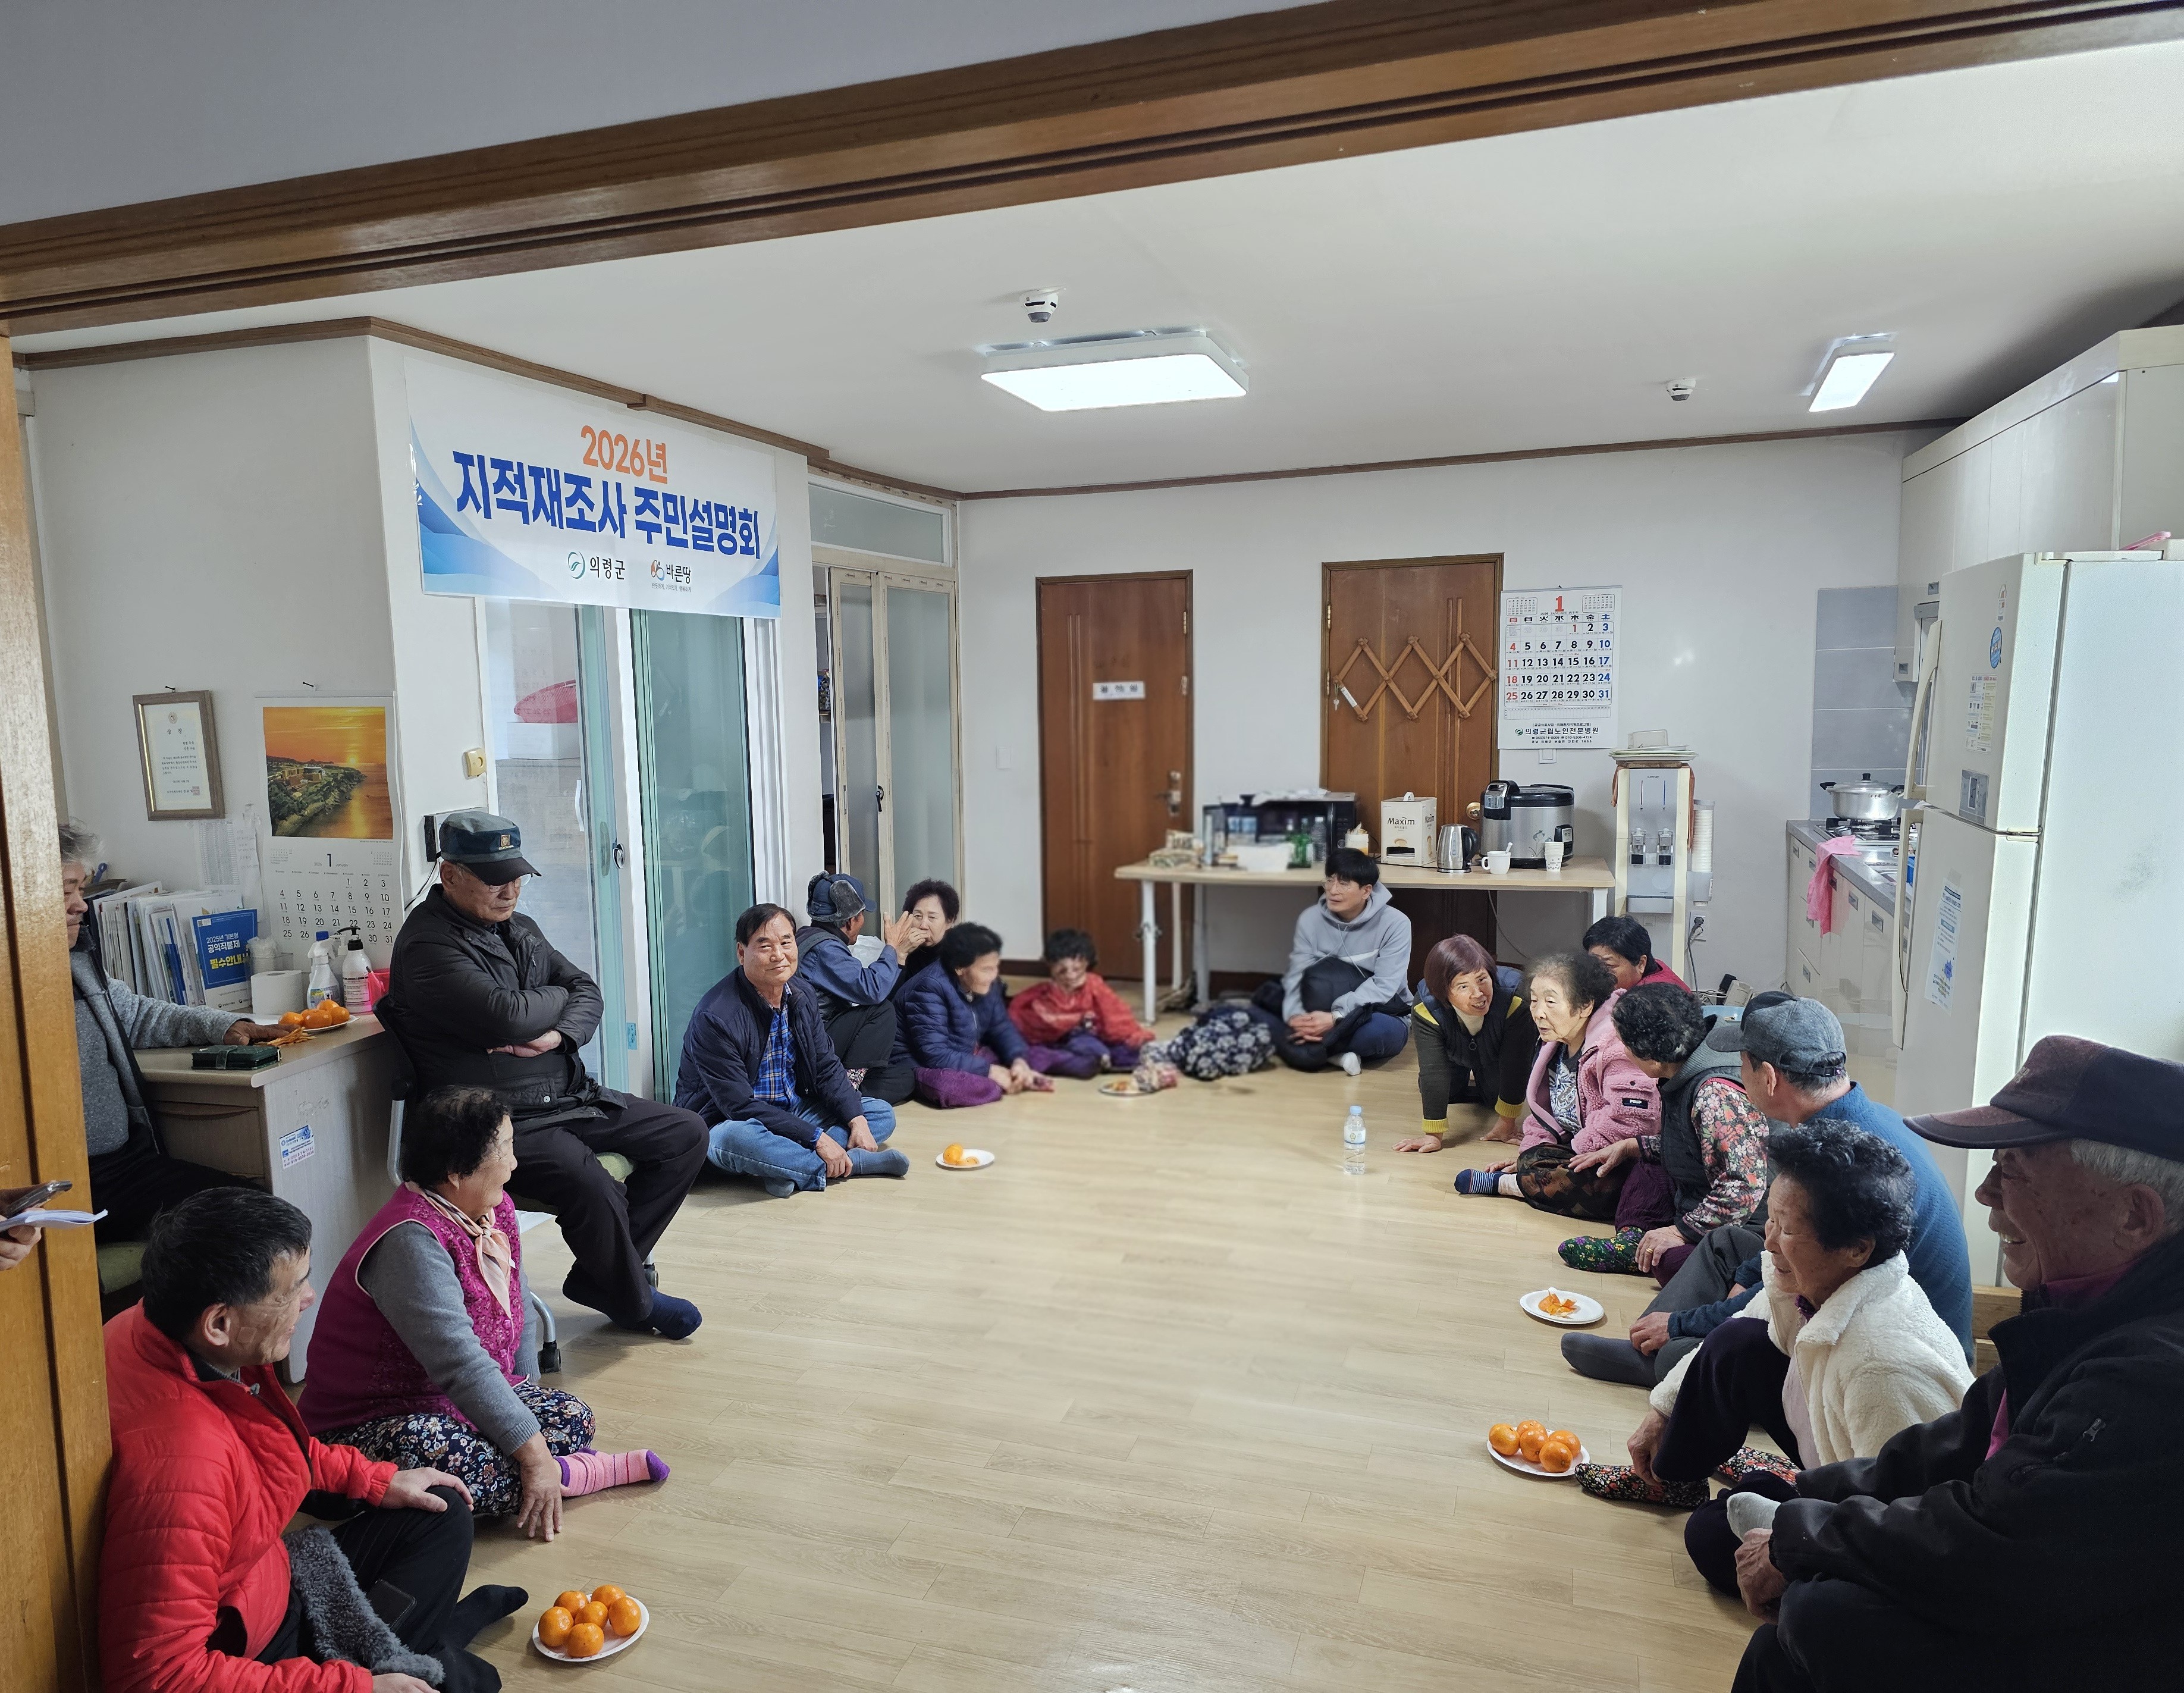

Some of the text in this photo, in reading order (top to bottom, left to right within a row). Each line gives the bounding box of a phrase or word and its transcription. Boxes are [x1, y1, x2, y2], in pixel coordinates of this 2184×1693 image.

[580, 425, 669, 484] 2026년
[453, 450, 761, 560] 지적재조사 주민설명회
[590, 556, 625, 579] 의령군
[666, 564, 691, 584] 바른땅
[1555, 596, 1564, 612] 1
[1584, 657, 1595, 665] 16
[1583, 673, 1595, 682] 23
[327, 854, 331, 867] 1
[206, 935, 224, 943] 2025년
[208, 940, 240, 953] 공익직불제
